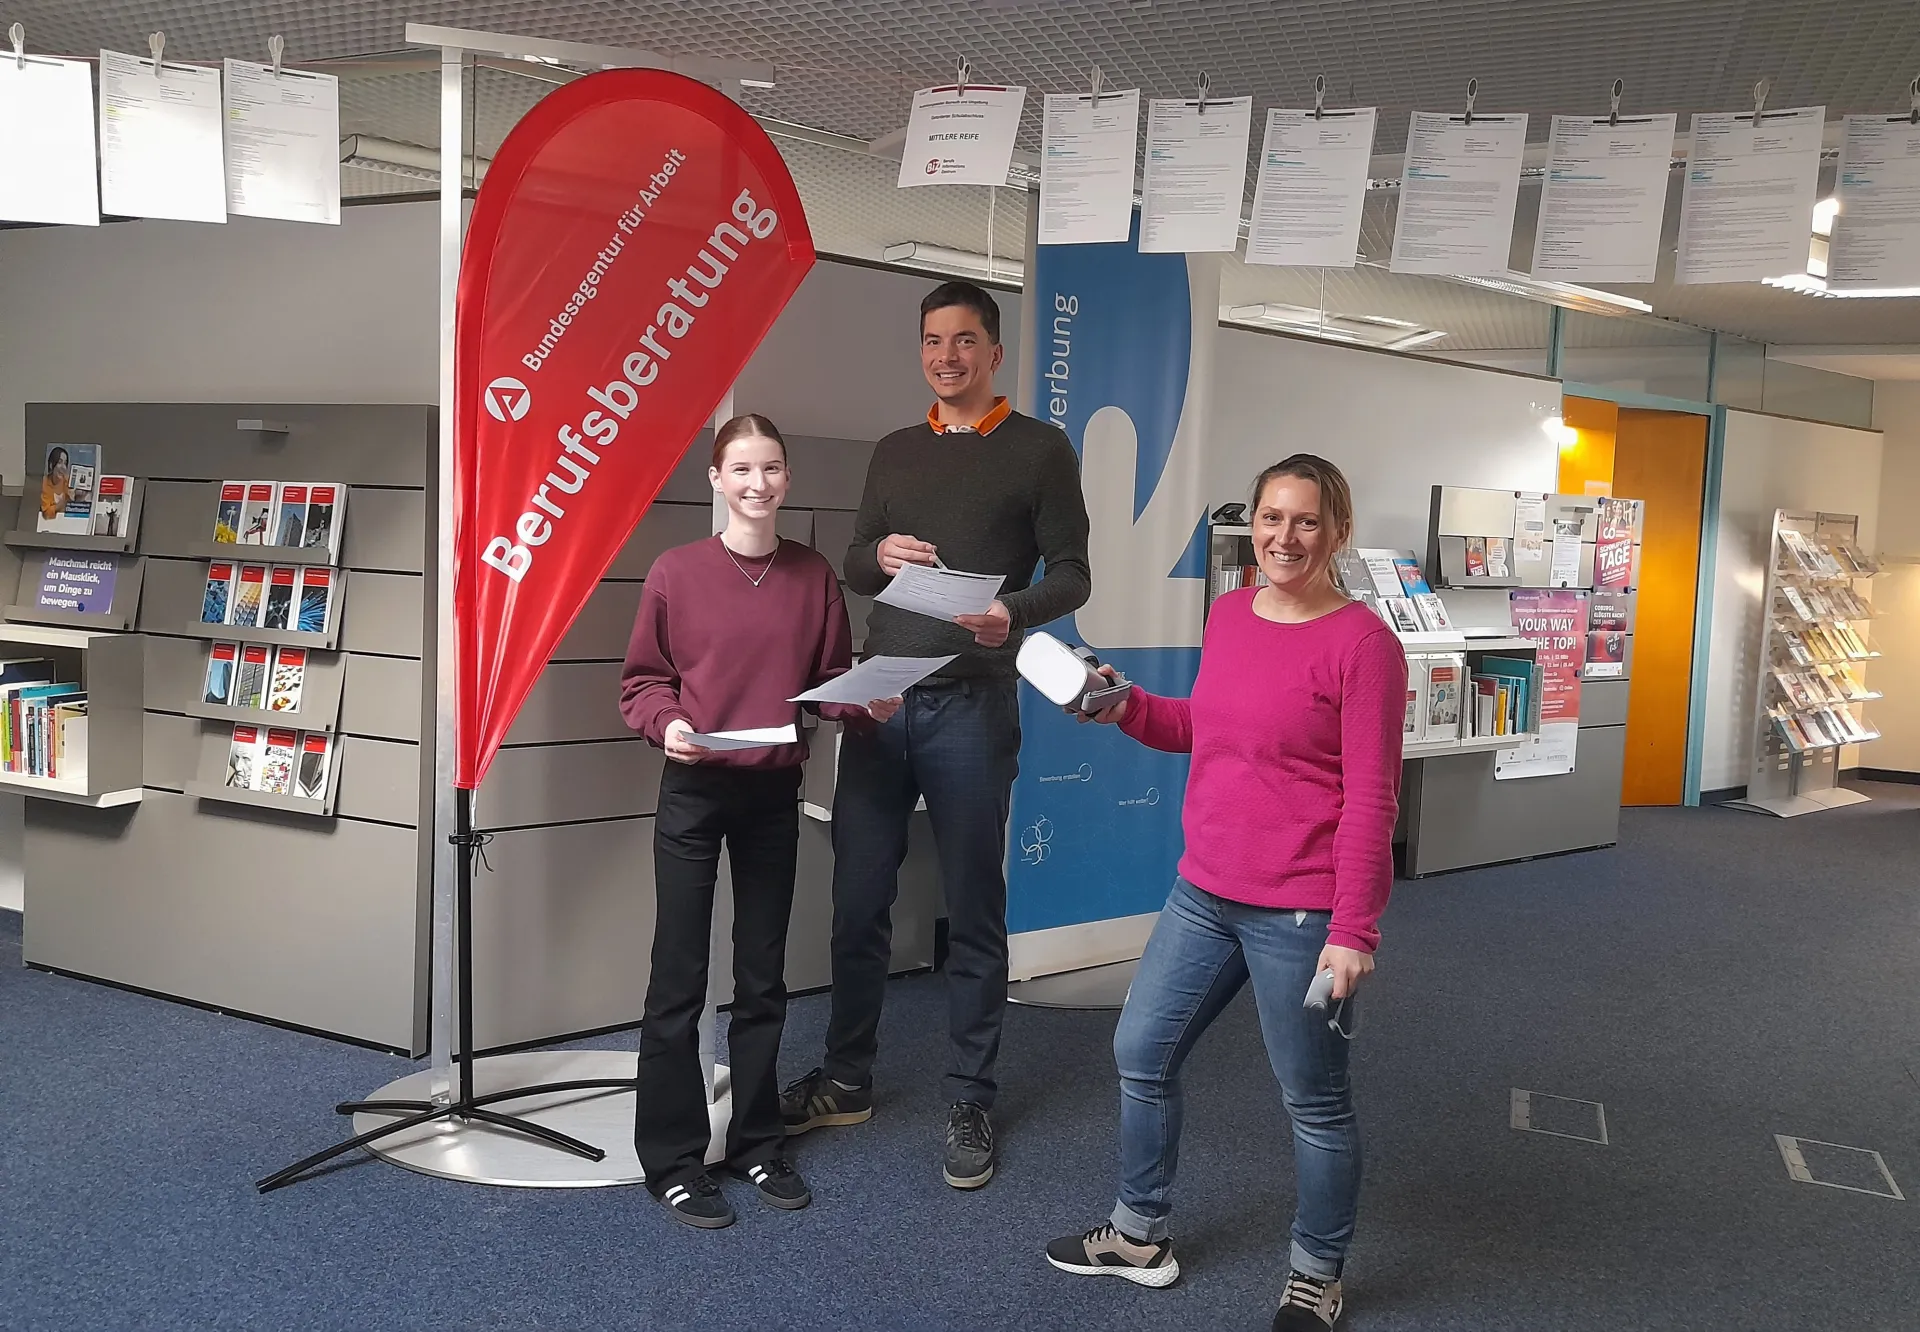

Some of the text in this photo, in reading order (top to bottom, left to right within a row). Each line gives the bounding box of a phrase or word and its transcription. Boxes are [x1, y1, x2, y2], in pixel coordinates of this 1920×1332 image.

[929, 133, 958, 142] MITTLERE
[521, 148, 687, 372] Bundesagentur für Arbeit
[480, 187, 779, 584] Berufsberatung
[48, 556, 112, 571] Manchmal reicht
[1600, 546, 1630, 571] TAGE
[46, 570, 100, 584] ein Mausklick,
[44, 584, 56, 592] um
[58, 584, 82, 596] Dinge
[41, 595, 79, 608] bewegen.
[1519, 618, 1574, 631] YOUR WAY
[1553, 637, 1576, 650] TOP!
